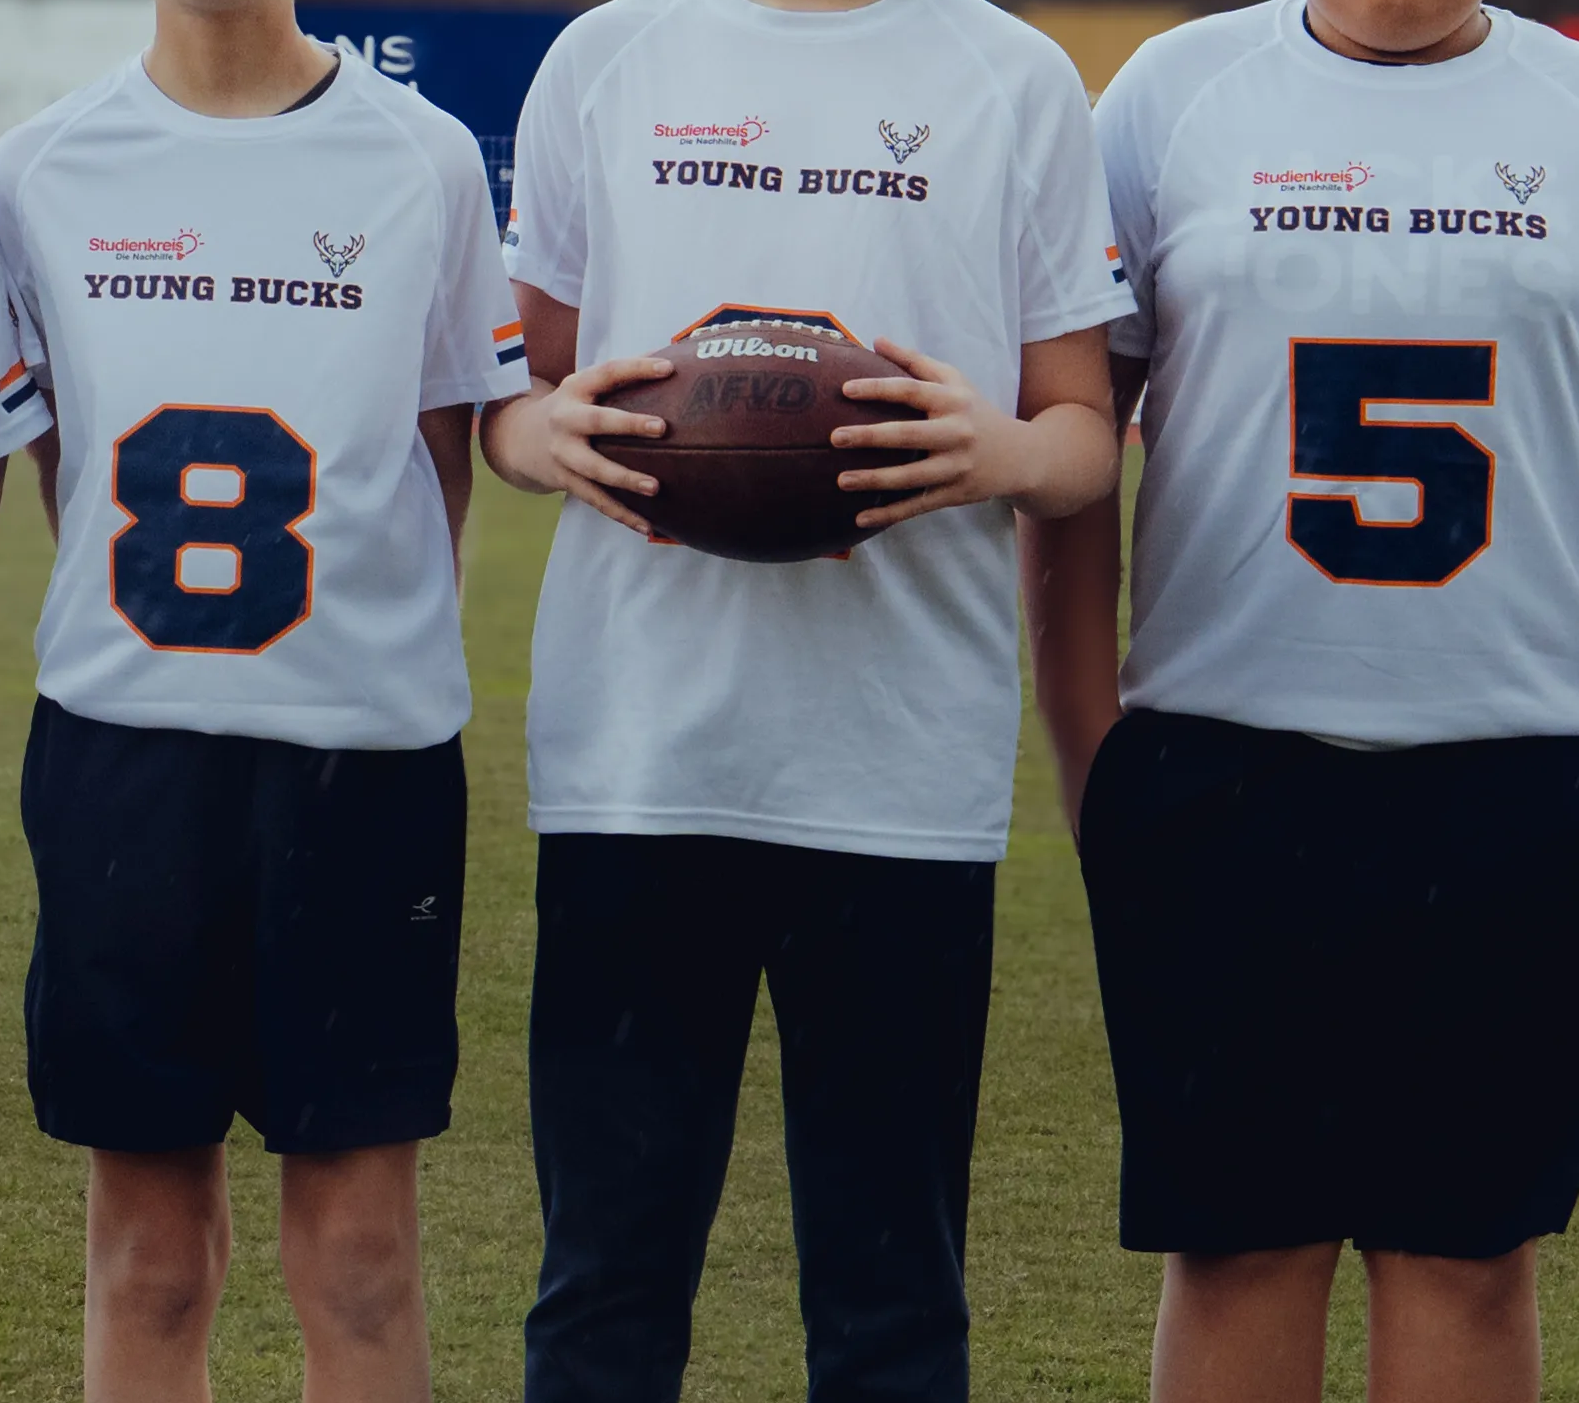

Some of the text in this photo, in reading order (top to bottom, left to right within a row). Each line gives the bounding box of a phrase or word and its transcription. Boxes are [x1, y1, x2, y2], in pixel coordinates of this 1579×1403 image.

[654, 123, 748, 138] Studienkreis
[679, 138, 693, 146] Die
[652, 160, 930, 202] YOUNG BUCKS
[1253, 169, 1353, 185] Studienkreis
[1280, 184, 1295, 192] Die
[1249, 206, 1547, 240] YOUNG BUCKS
[89, 237, 184, 253] Studienkreis
[115, 253, 130, 261] Die
[84, 274, 363, 310] YOUNG BUCKS
[696, 337, 819, 363] Wilson
[681, 371, 818, 417] AFVD
[1286, 337, 1497, 586] 5
[109, 403, 317, 655] 8
